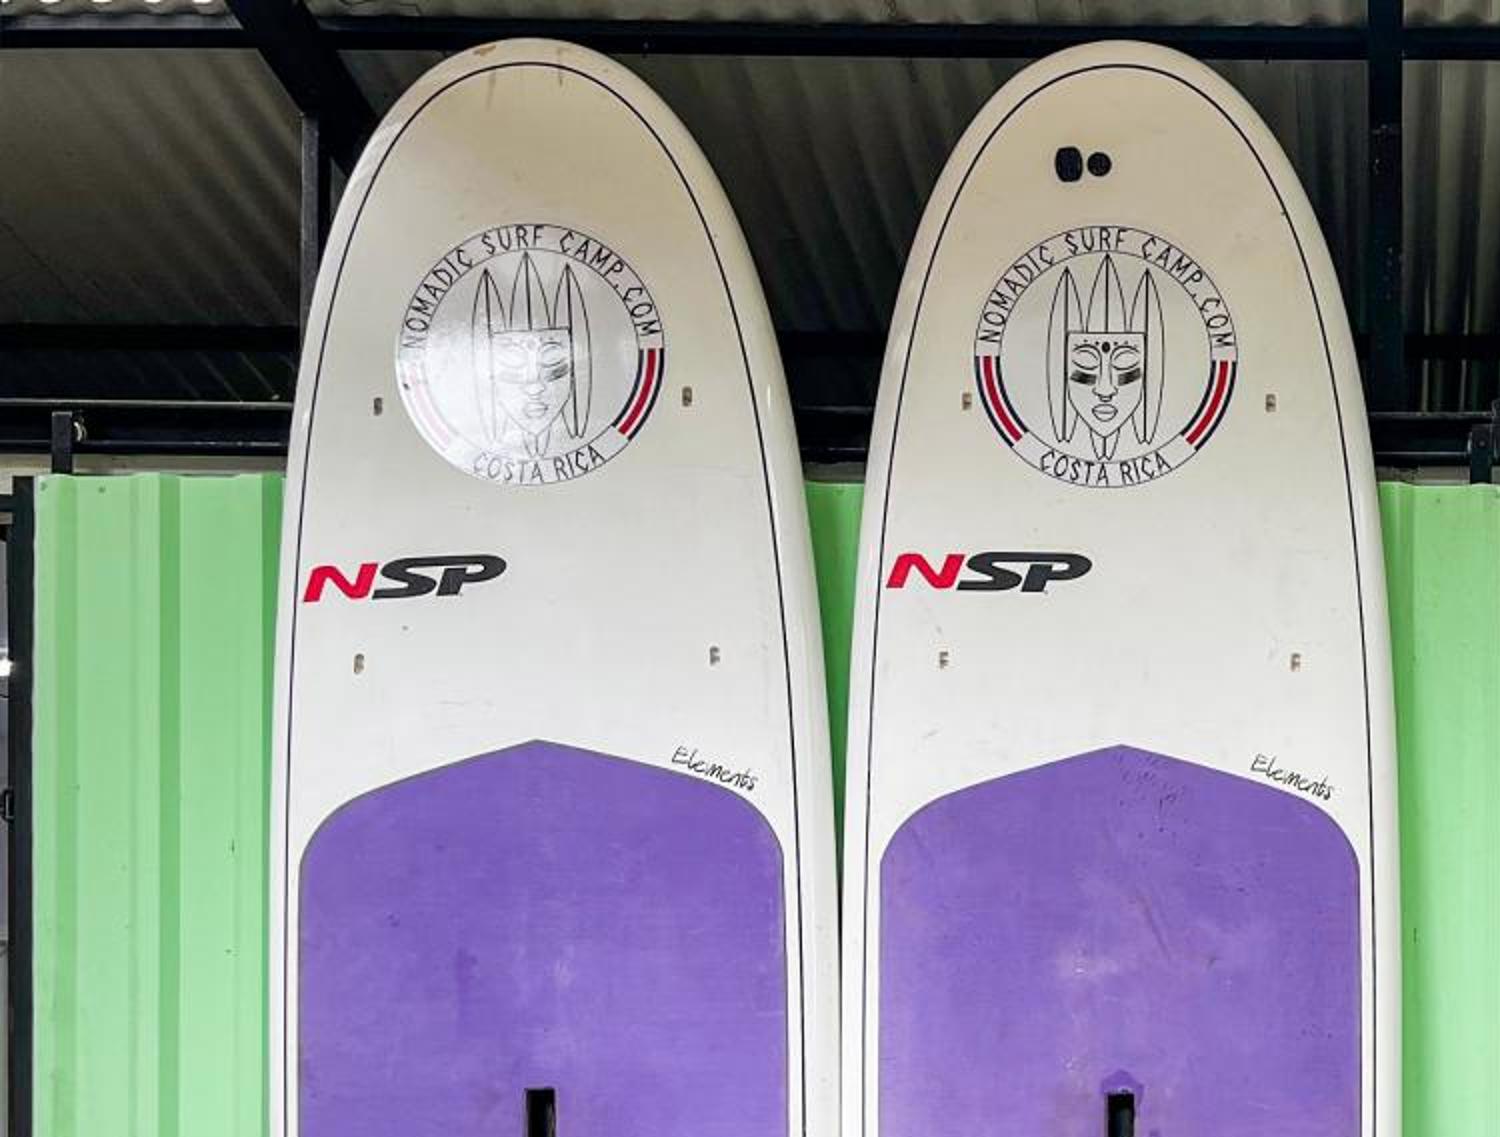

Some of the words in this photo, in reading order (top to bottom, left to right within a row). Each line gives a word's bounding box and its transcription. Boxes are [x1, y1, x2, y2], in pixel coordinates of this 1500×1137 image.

[402, 247, 474, 350] NOMADIC
[481, 224, 545, 255] SURF
[979, 244, 1055, 345] NOMADIC
[1064, 226, 1128, 256] SURF
[472, 452, 545, 484] COSTA
[553, 444, 606, 482] RICA
[1040, 450, 1110, 486] COSTA
[1119, 450, 1173, 484] RICA
[303, 554, 508, 604] NSP
[885, 551, 1094, 594] NSP
[671, 745, 758, 791] Elements
[1250, 753, 1334, 800] Elements
